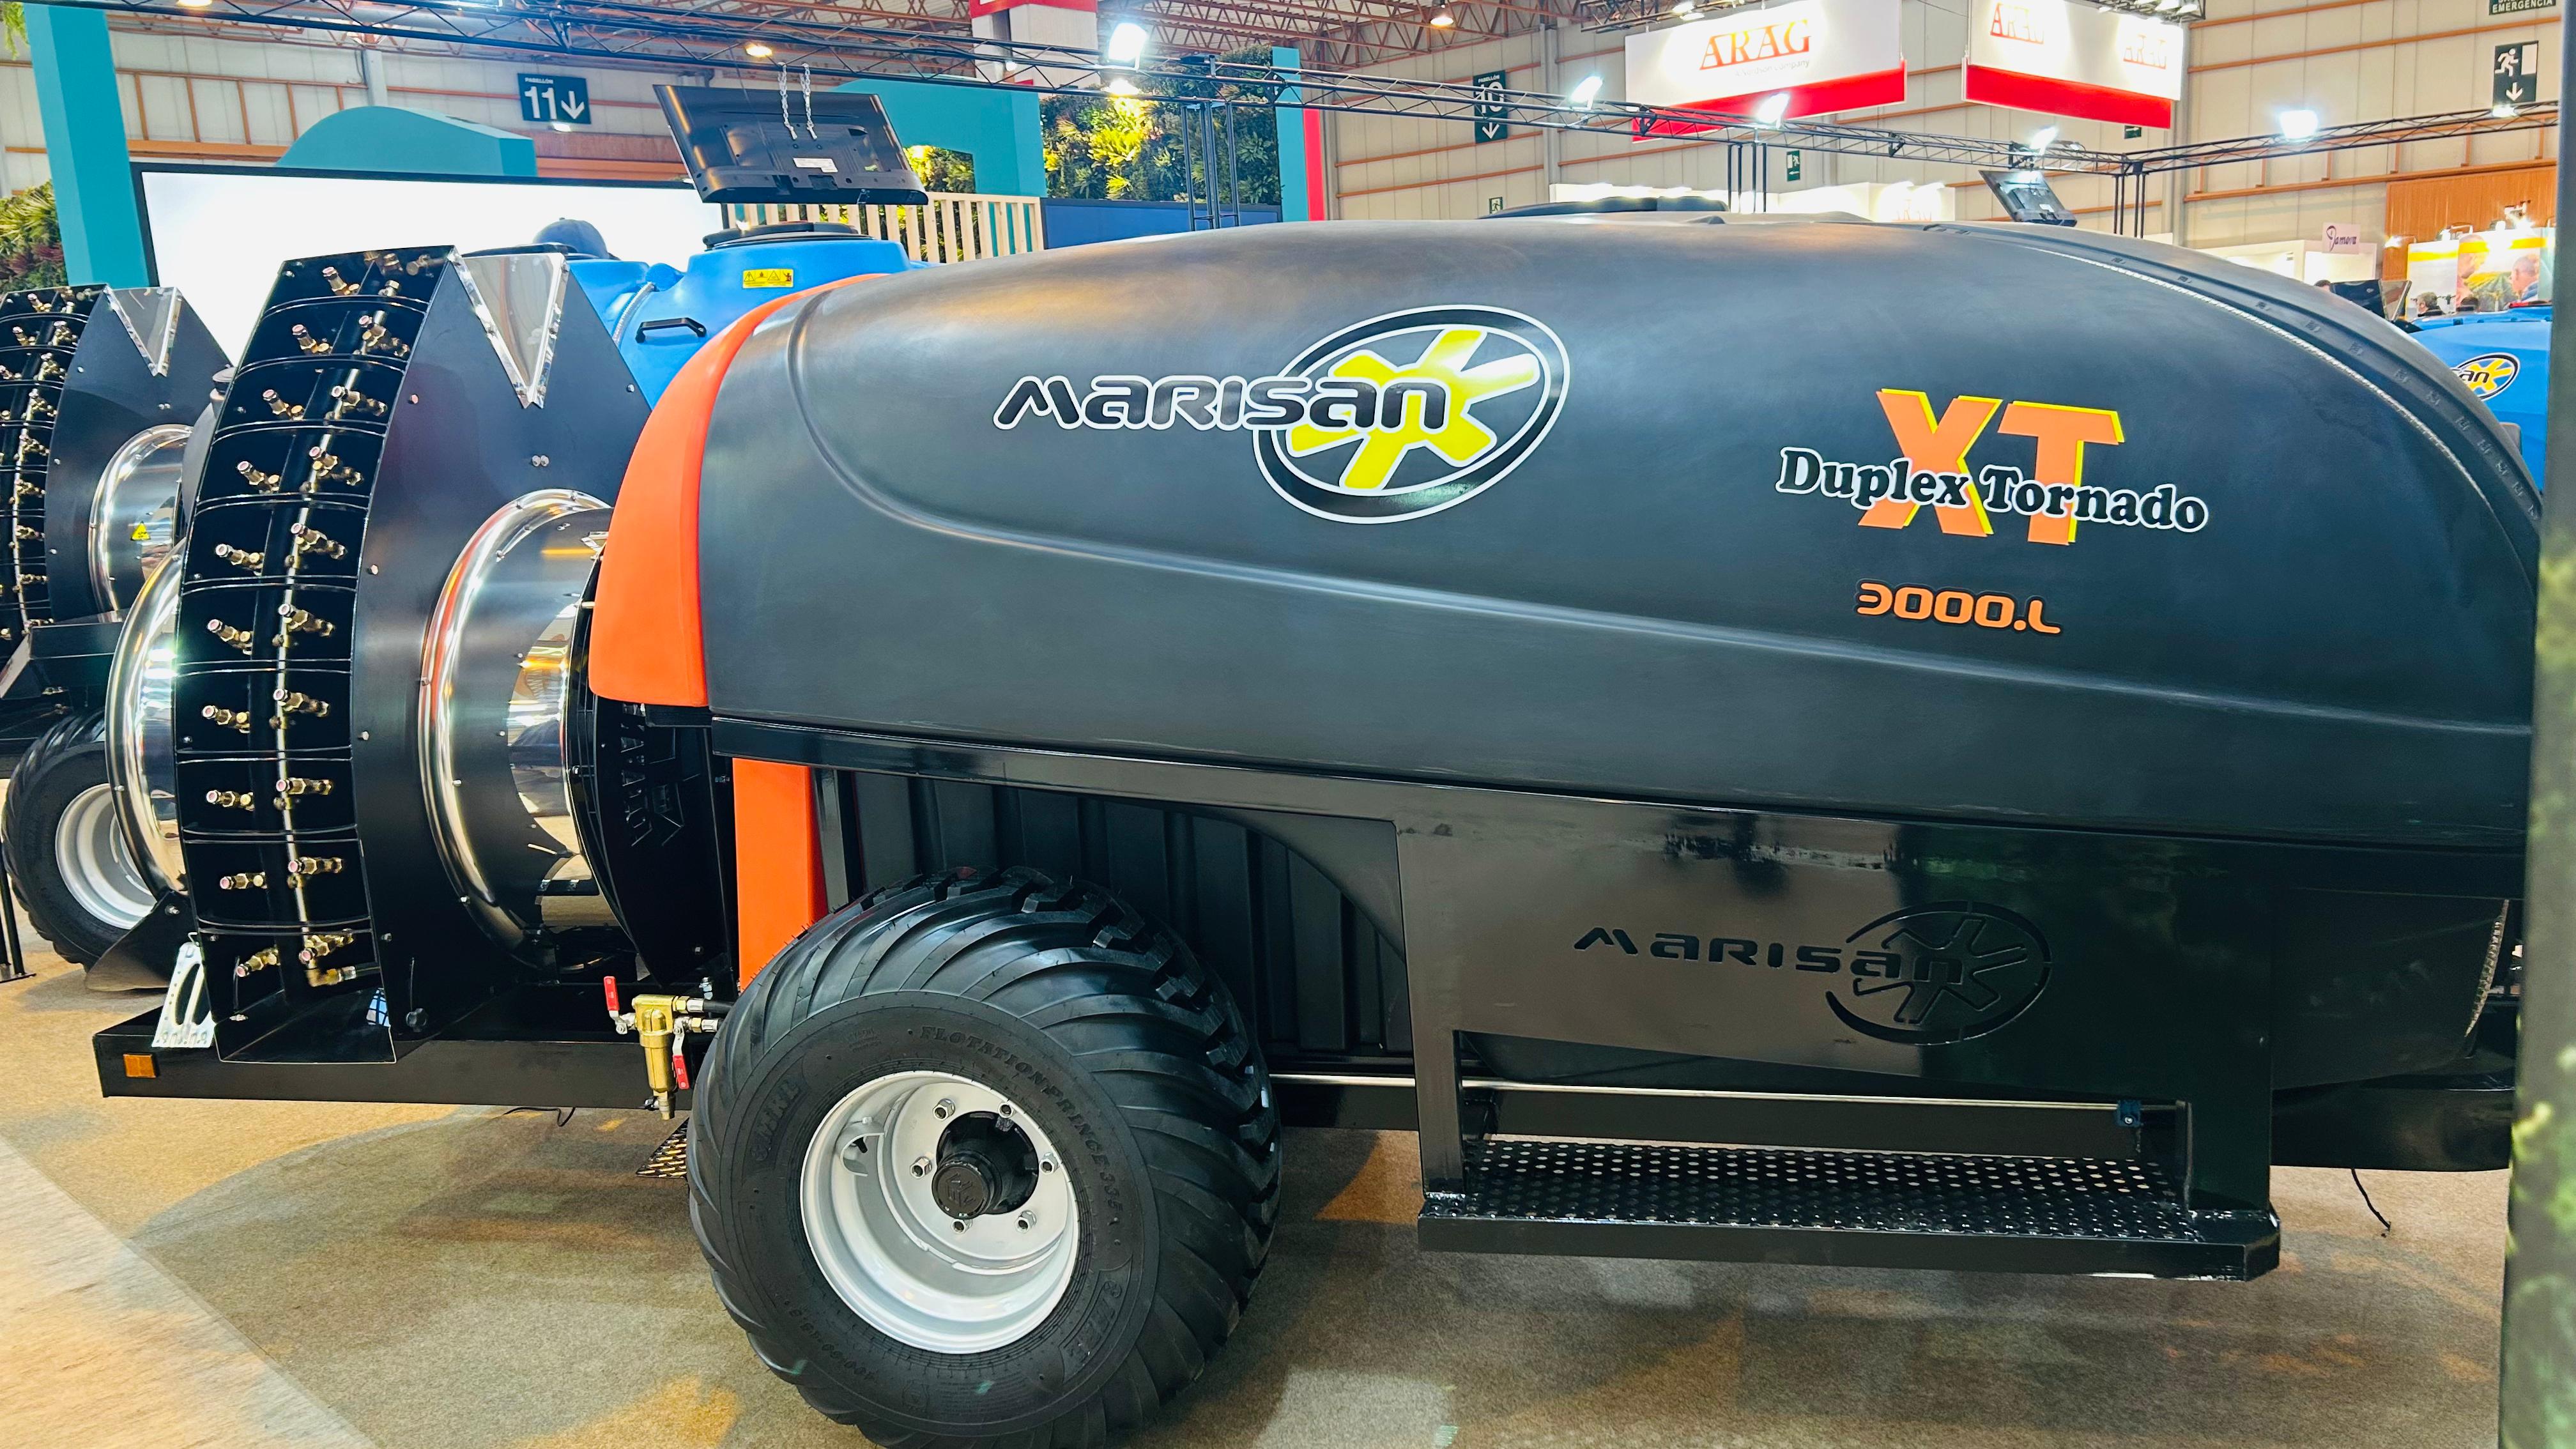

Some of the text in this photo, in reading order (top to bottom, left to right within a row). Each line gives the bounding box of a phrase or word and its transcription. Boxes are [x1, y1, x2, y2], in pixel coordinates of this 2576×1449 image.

[1699, 19, 1811, 70] ARAG
[524, 86, 558, 119] 11
[1475, 81, 1505, 112] 10
[1775, 447, 2209, 533] Duplex Tornado
[1858, 388, 2125, 546] XT
[921, 1025, 1049, 1085] FLOTATION
